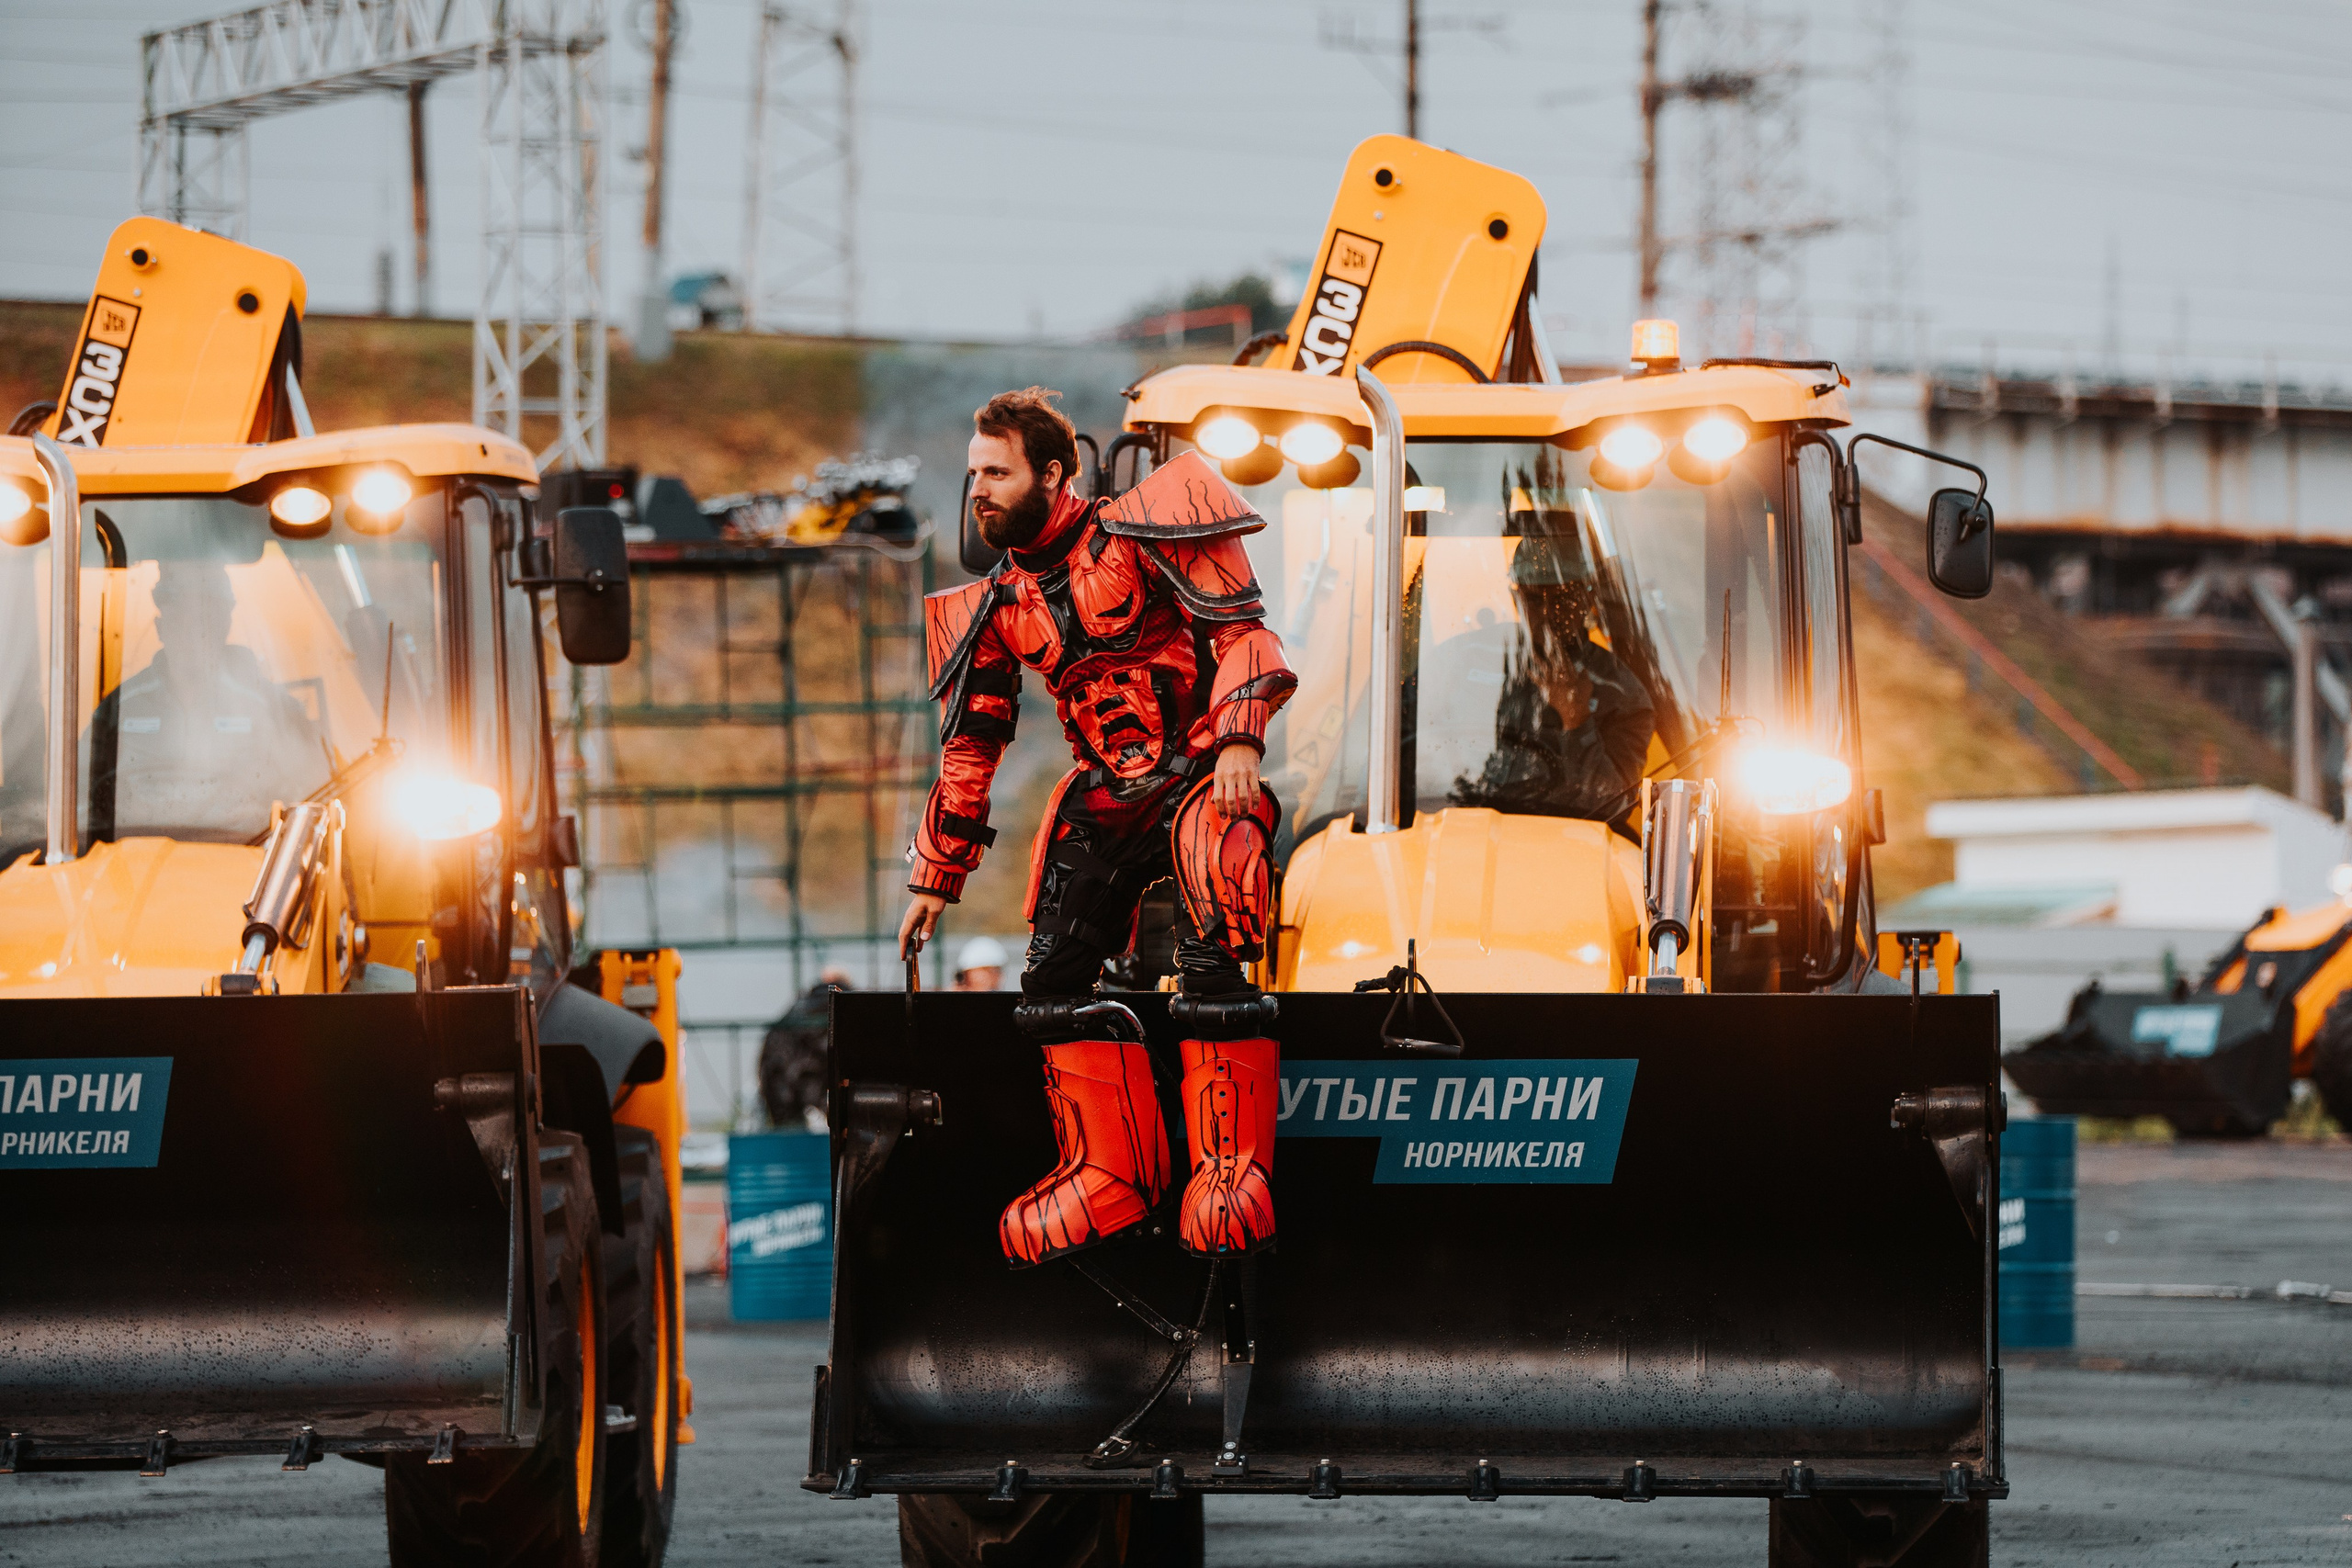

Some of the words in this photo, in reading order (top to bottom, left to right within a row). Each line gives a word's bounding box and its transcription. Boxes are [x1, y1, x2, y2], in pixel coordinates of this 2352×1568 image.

[1298, 278, 1363, 377] 3CX
[57, 341, 123, 448] 3CX
[1277, 1077, 1418, 1121] УТЫЕ
[1430, 1077, 1604, 1121] ПАРНИ
[1, 1130, 130, 1156] РНИКЕЛЯ
[1403, 1141, 1586, 1168] НОРНИКЕЛЯ
